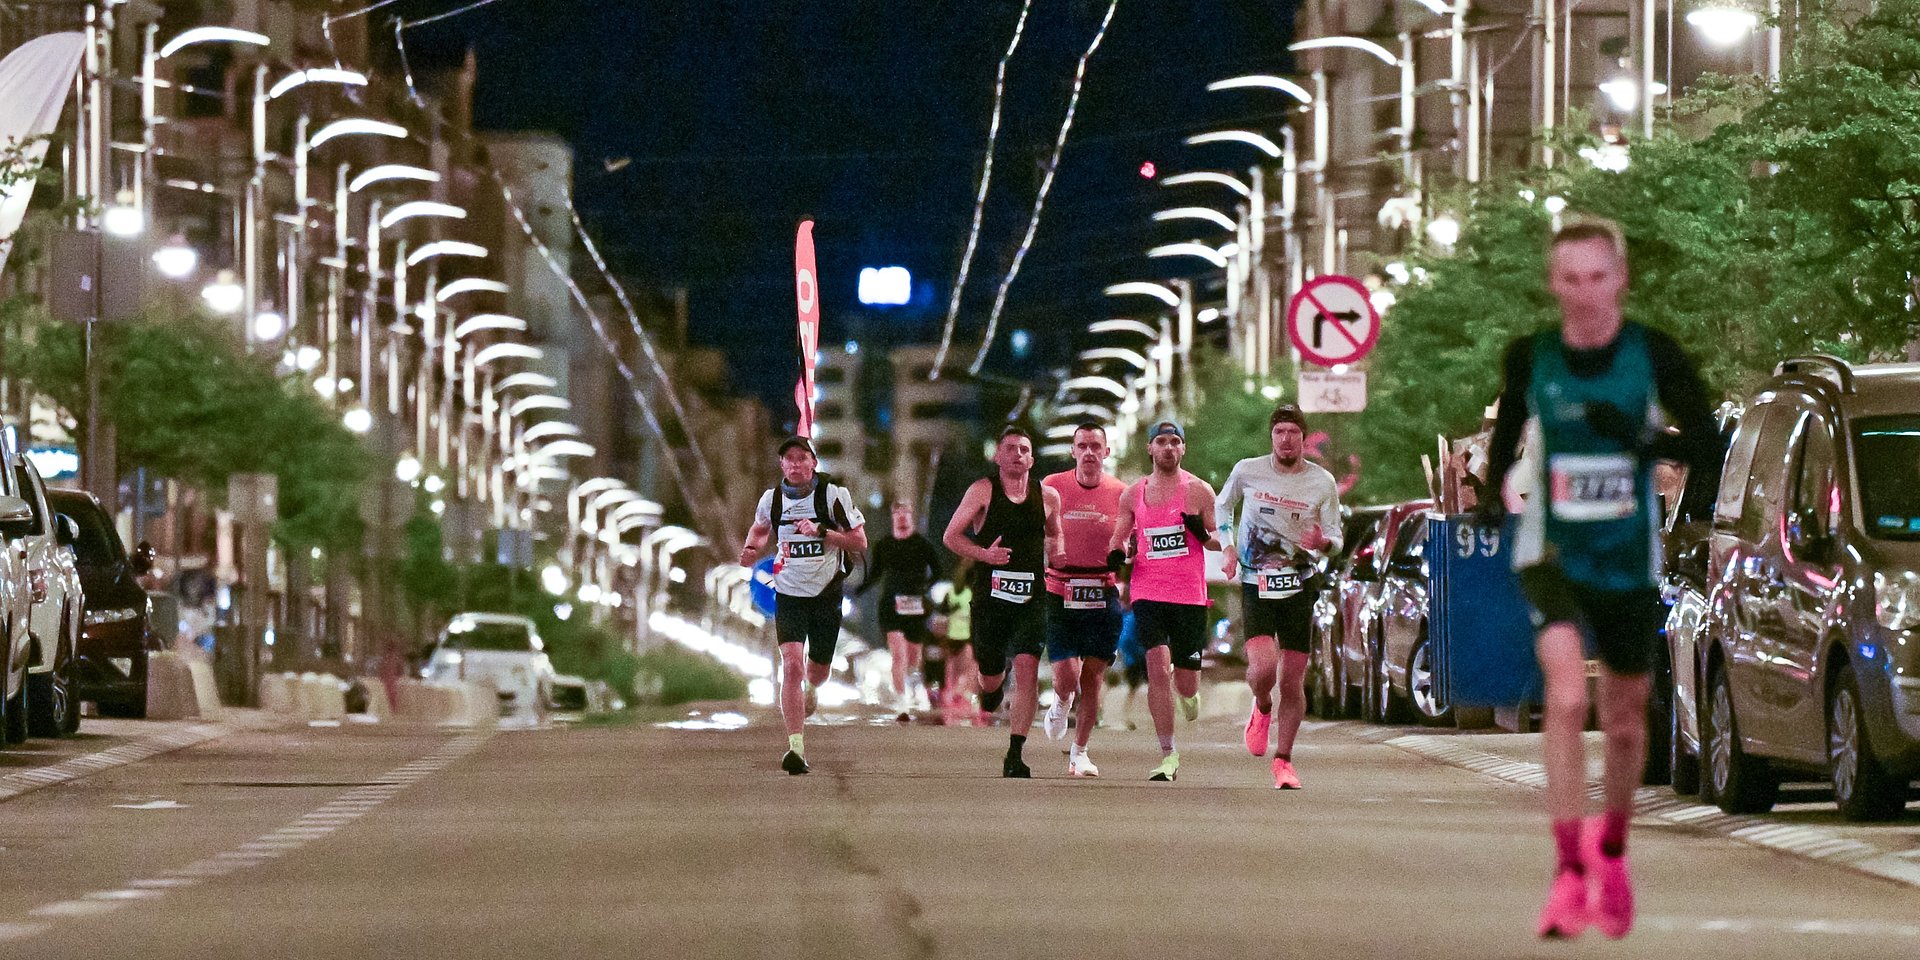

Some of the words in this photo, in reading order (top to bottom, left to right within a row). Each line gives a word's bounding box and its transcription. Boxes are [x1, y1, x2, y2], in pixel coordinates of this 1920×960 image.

[1153, 535, 1185, 549] 4062
[1456, 522, 1500, 558] 99
[790, 543, 822, 555] 4112
[1000, 580, 1032, 593] 2431
[1267, 576, 1300, 589] 4554
[1074, 588, 1103, 599] 1143
